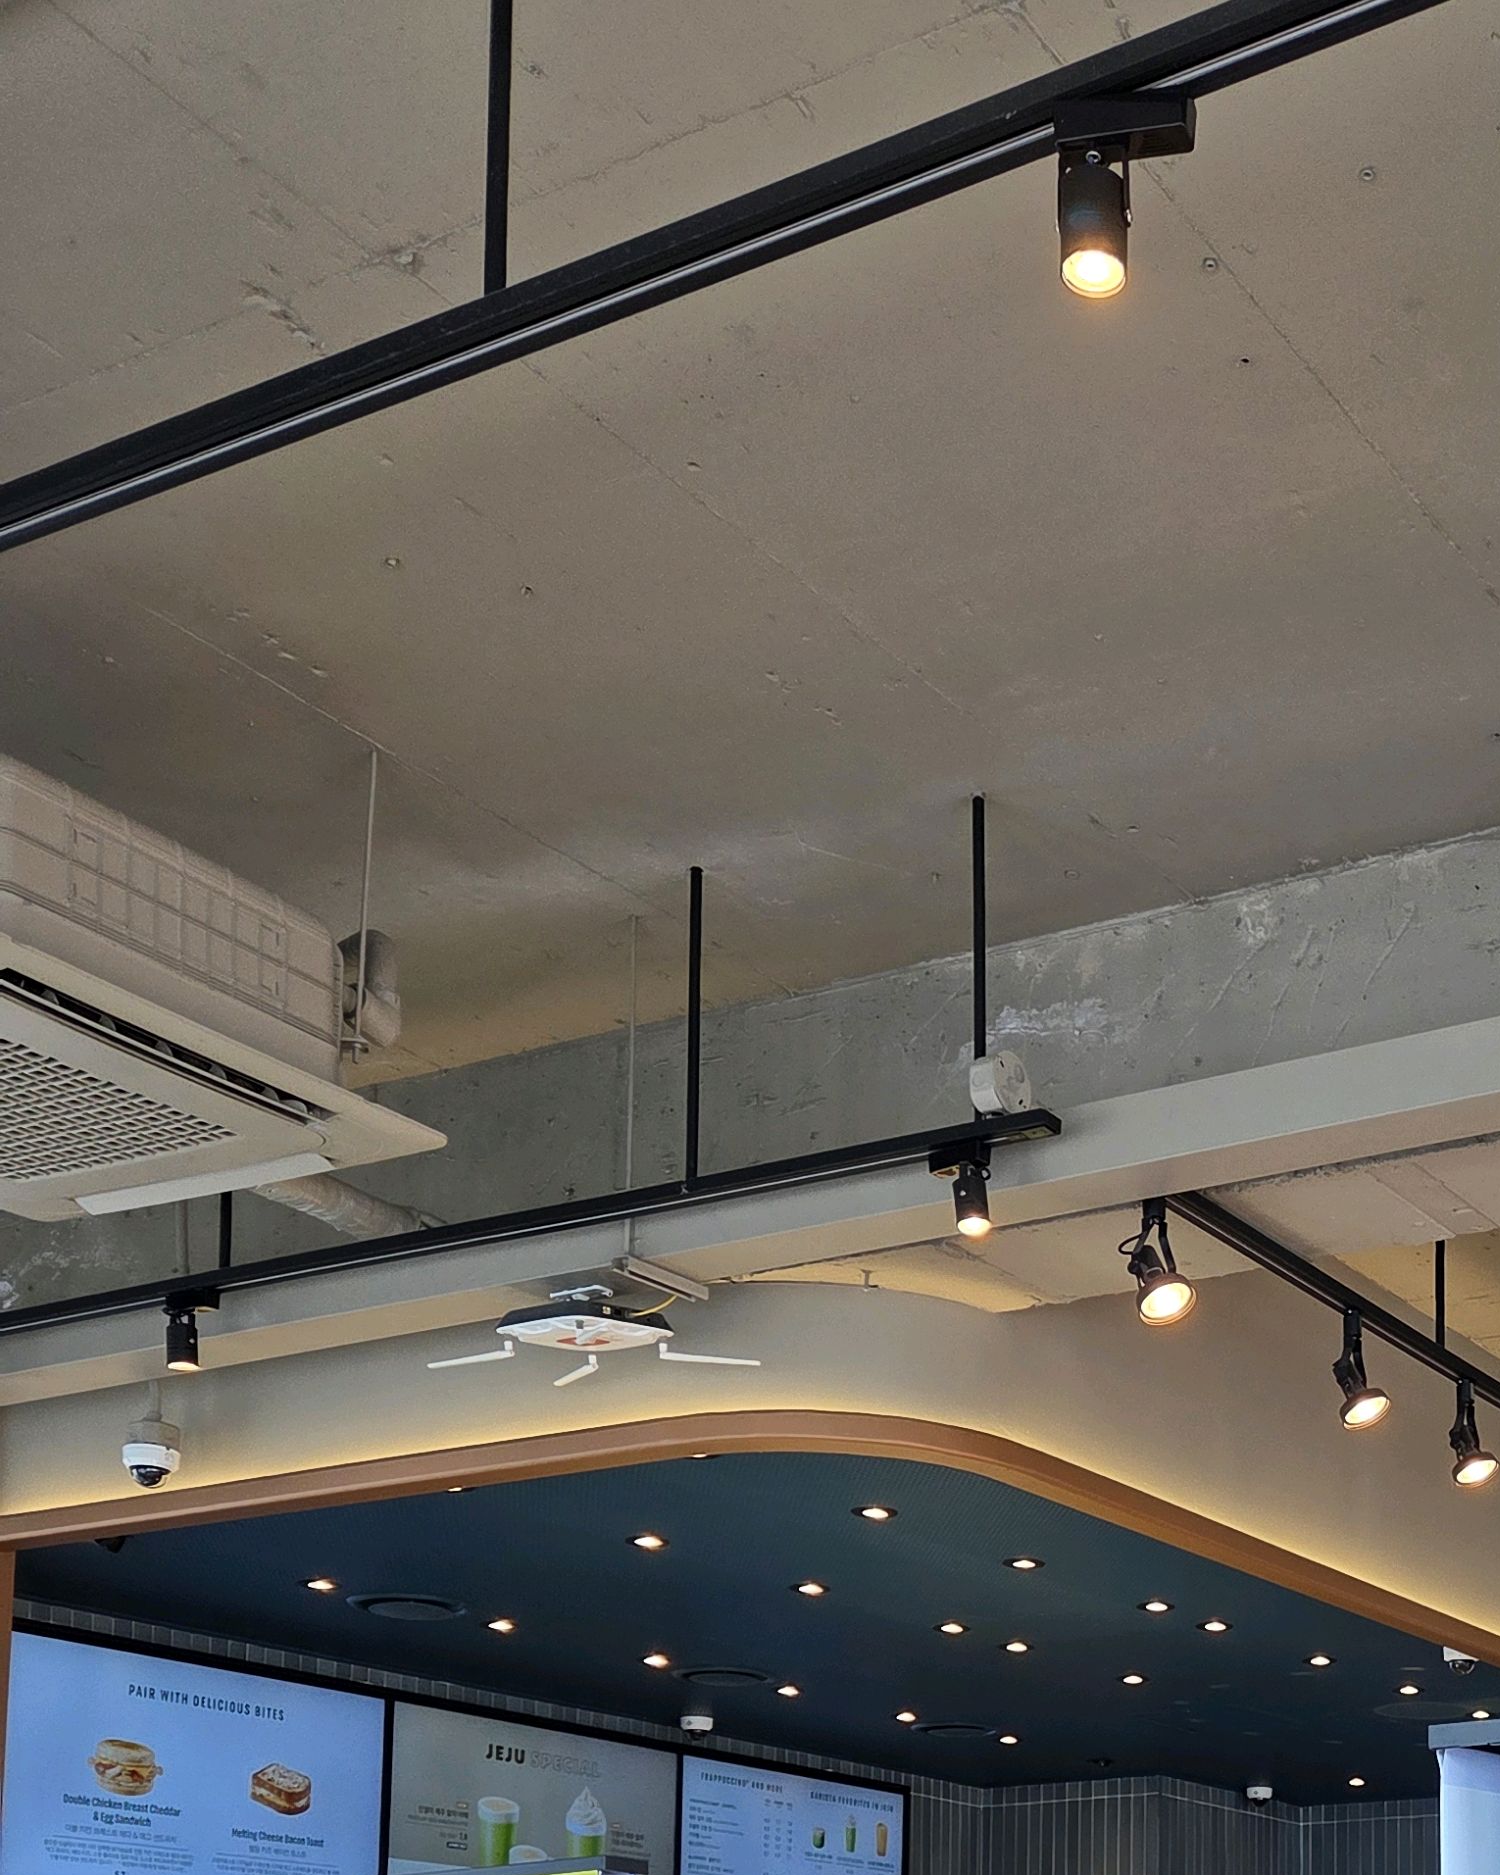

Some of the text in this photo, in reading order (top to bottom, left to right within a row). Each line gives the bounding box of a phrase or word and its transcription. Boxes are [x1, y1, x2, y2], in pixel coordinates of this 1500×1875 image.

[128, 1684, 284, 1721] PAIR WITH DELICIOUS BITES
[486, 1743, 600, 1778] JEJU SPECIAL
[63, 1794, 181, 1817] Double Chicken Breast Cheddar
[100, 1812, 114, 1825] Egg
[115, 1814, 152, 1827] Sandwich
[232, 1828, 258, 1842] Melting
[258, 1831, 283, 1844] Cheese
